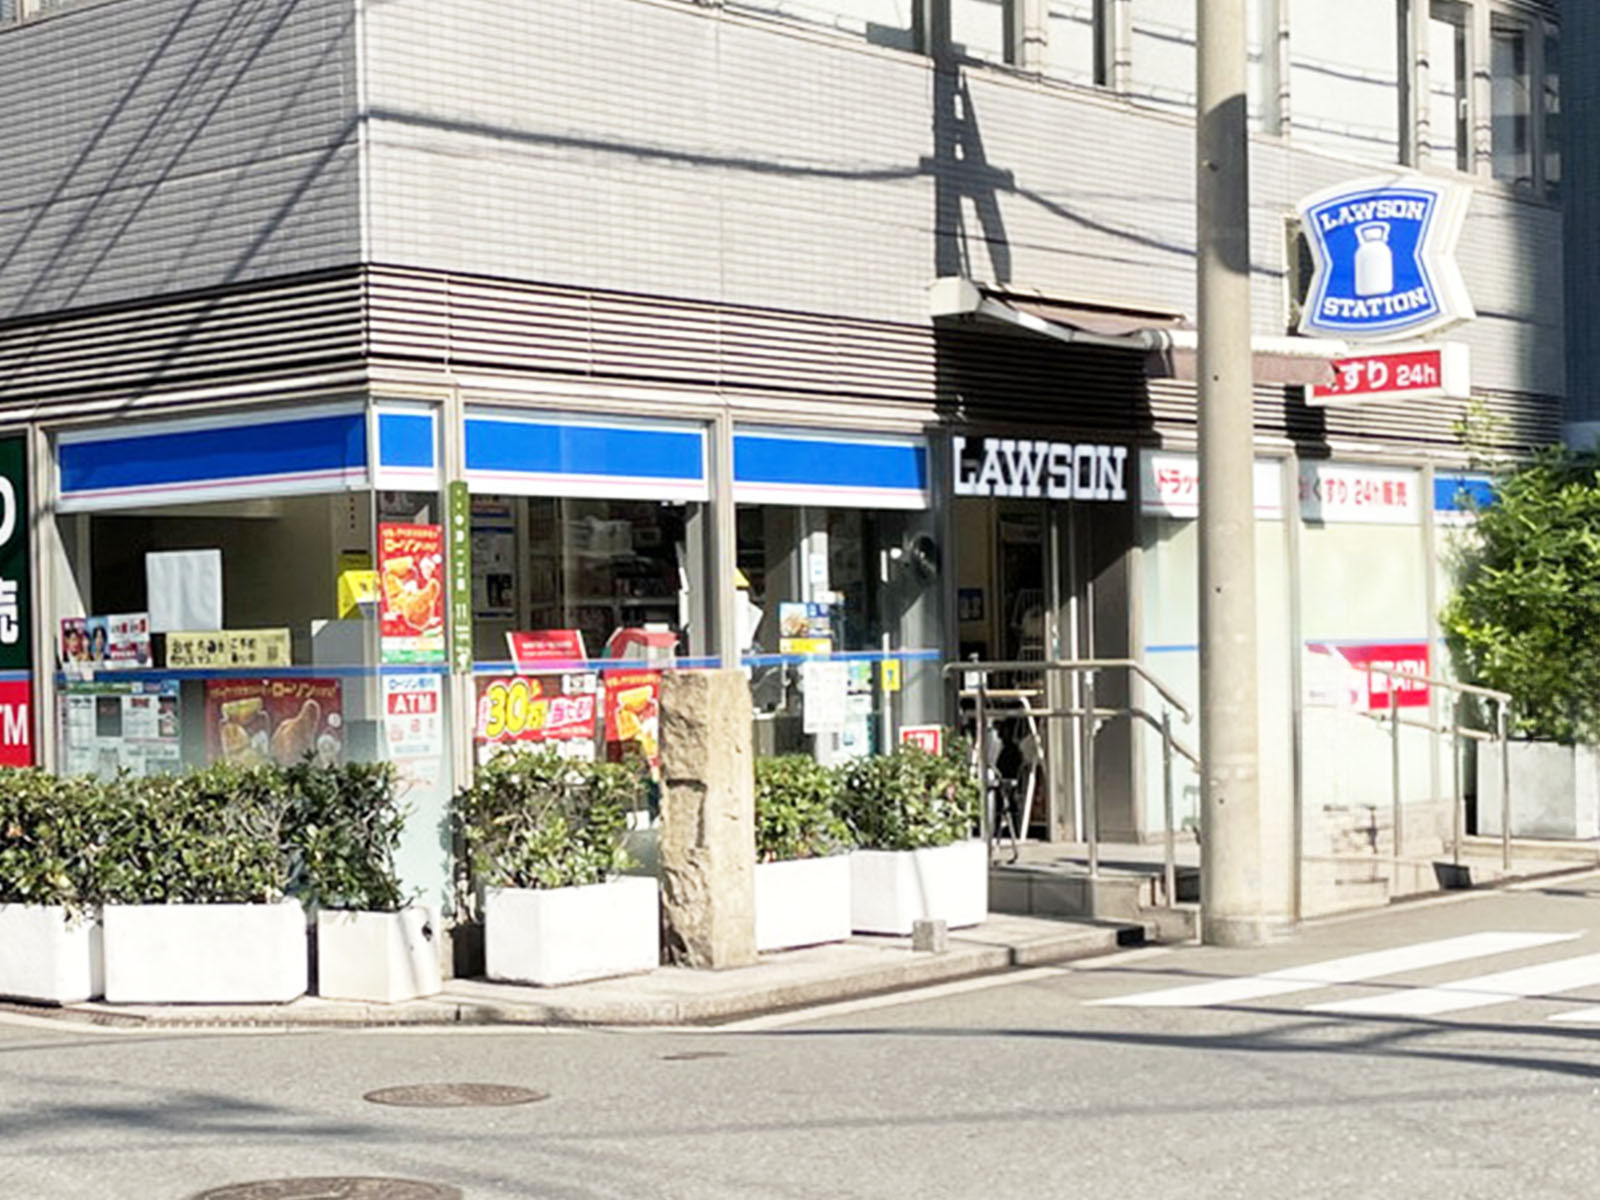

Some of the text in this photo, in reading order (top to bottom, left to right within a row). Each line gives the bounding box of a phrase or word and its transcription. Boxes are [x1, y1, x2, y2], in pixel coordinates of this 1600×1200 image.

[1319, 199, 1426, 232] LAWSON
[1323, 286, 1428, 318] STATION
[1326, 360, 1437, 391] すり 24h
[953, 436, 1127, 500] LAWSON
[393, 693, 432, 714] ATM
